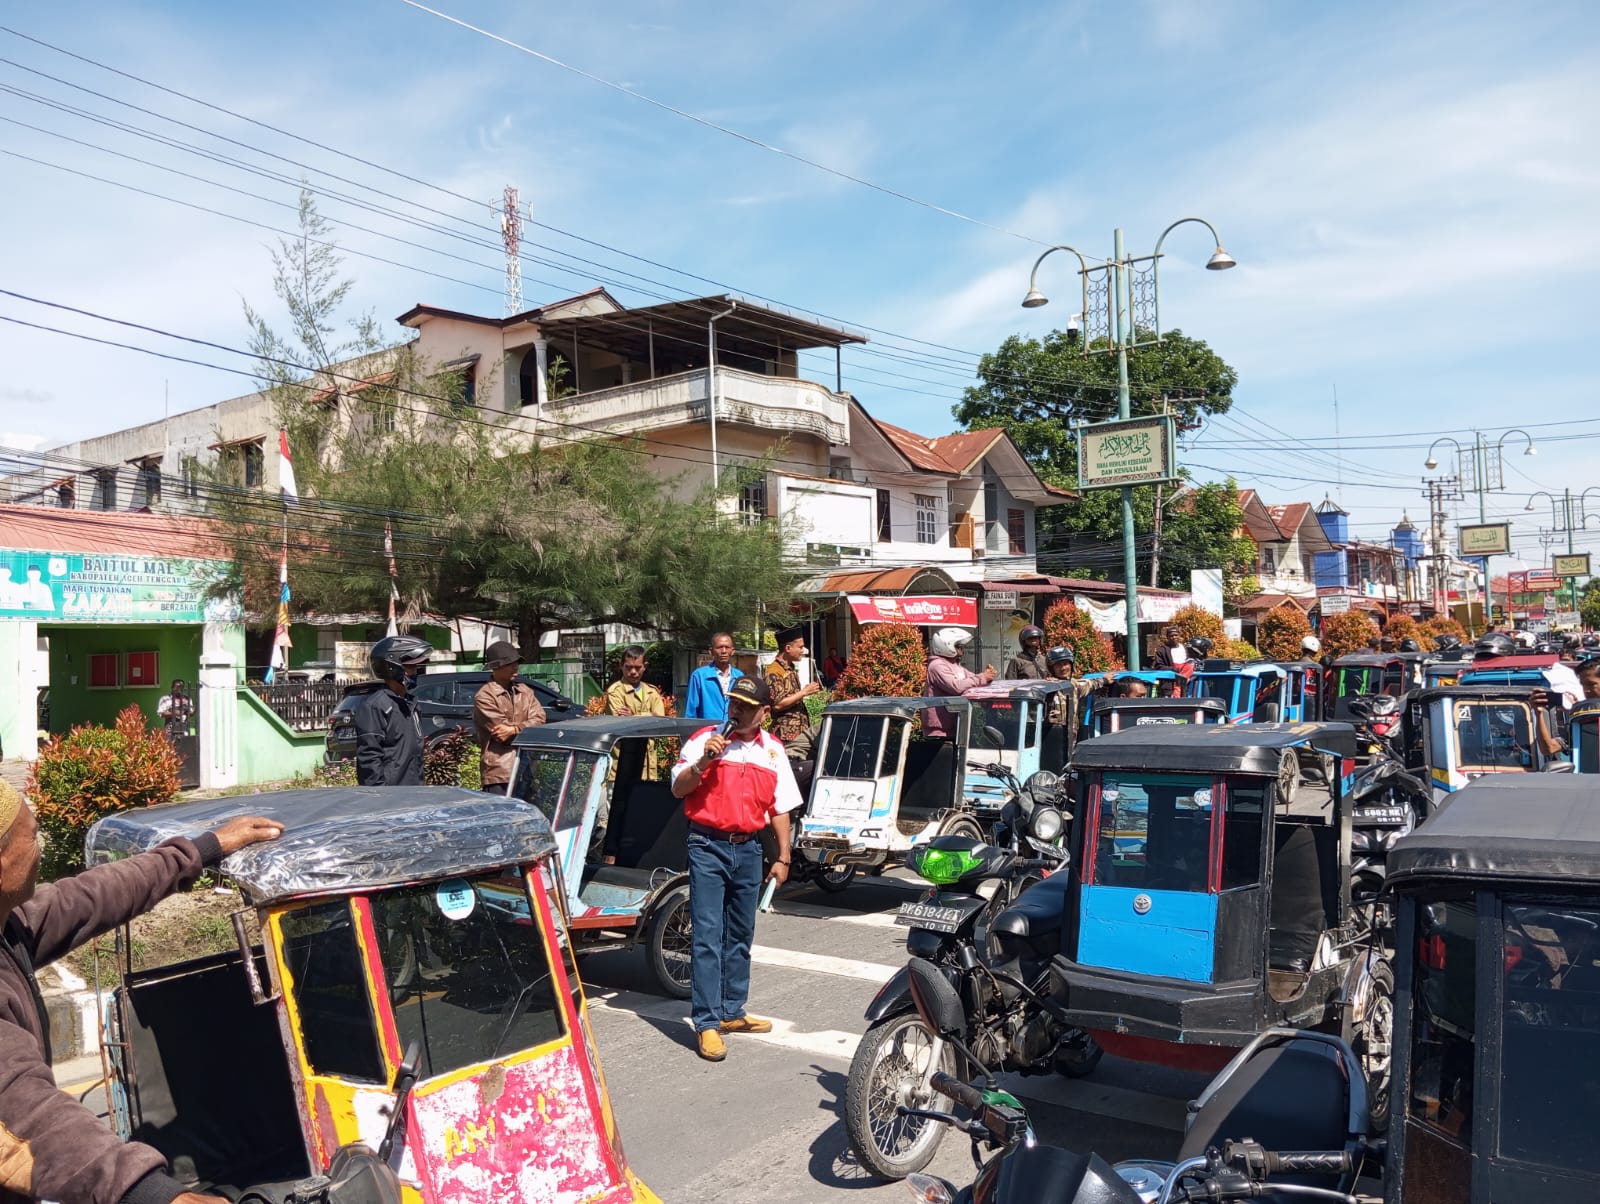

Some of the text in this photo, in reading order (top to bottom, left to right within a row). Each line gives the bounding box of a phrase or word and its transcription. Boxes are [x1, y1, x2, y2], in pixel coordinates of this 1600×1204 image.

[1101, 468, 1113, 476] DAN
[83, 558, 174, 575] BAITUL MAL
[122, 574, 143, 583] ACEH
[63, 585, 132, 594] MARI TUNAIKAN
[63, 594, 132, 612] ZAKAT
[160, 602, 197, 612] BERZAKAT
